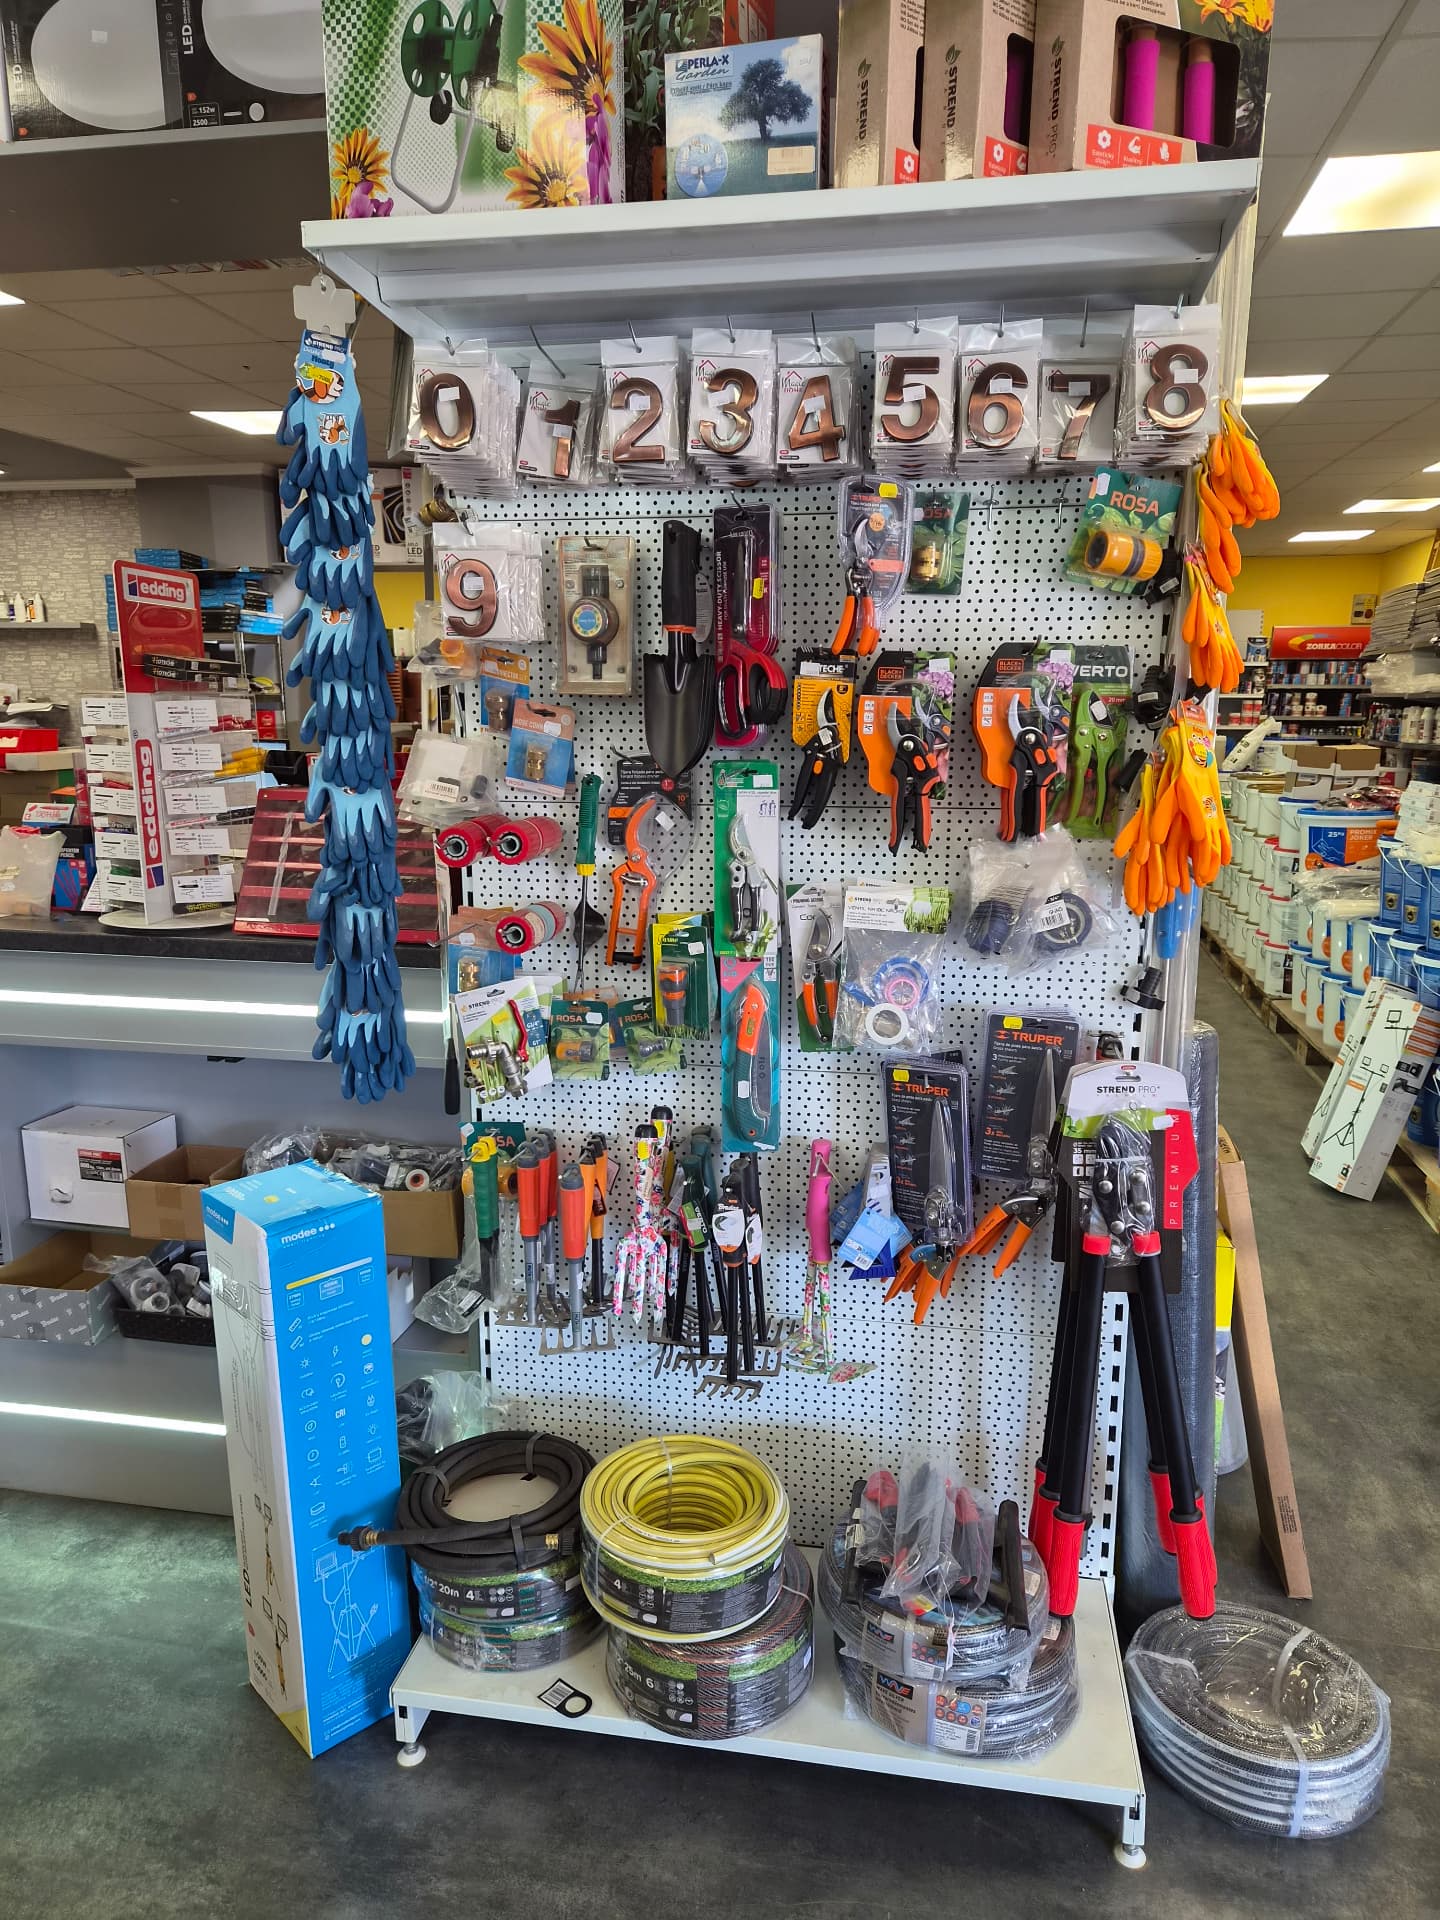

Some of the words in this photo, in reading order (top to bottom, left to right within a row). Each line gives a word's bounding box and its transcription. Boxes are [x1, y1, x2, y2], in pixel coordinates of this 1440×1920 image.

[182, 24, 194, 65] LED
[687, 53, 731, 71] PERLA-X
[676, 67, 730, 81] Garden
[947, 66, 958, 128] STREND
[1051, 58, 1062, 121] STREND
[859, 79, 870, 140] STREND
[191, 118, 208, 126] 2500
[1145, 343, 1209, 432] 8
[880, 356, 941, 442] 5
[968, 361, 1029, 448] 6
[612, 376, 666, 463] 2
[699, 367, 760, 455] 3
[788, 374, 847, 463] 4
[1050, 373, 1111, 461] 7
[1110, 490, 1160, 517] ROSA
[407, 547, 423, 555] LED
[140, 581, 185, 602] edding
[446, 557, 498, 638] 9
[819, 664, 845, 673] TECHE
[137, 746, 160, 859] edding
[468, 1000, 490, 1010] STREND
[556, 1014, 583, 1023] ROSA
[624, 1013, 650, 1023] ROSA
[1011, 1031, 1063, 1046] TRUPER
[992, 1053, 998, 1061] 3
[905, 1083, 949, 1097] TRUPER
[1096, 1086, 1137, 1094] STREND
[1138, 1086, 1157, 1094] PRO
[1169, 1114, 1180, 1226] PREMIUM
[281, 1228, 318, 1245] modee
[335, 1407, 346, 1419] CRI
[242, 1568, 253, 1609] LED
[613, 1578, 623, 1590] 4
[465, 1590, 475, 1601] 4
[645, 1677, 655, 1689] 6
